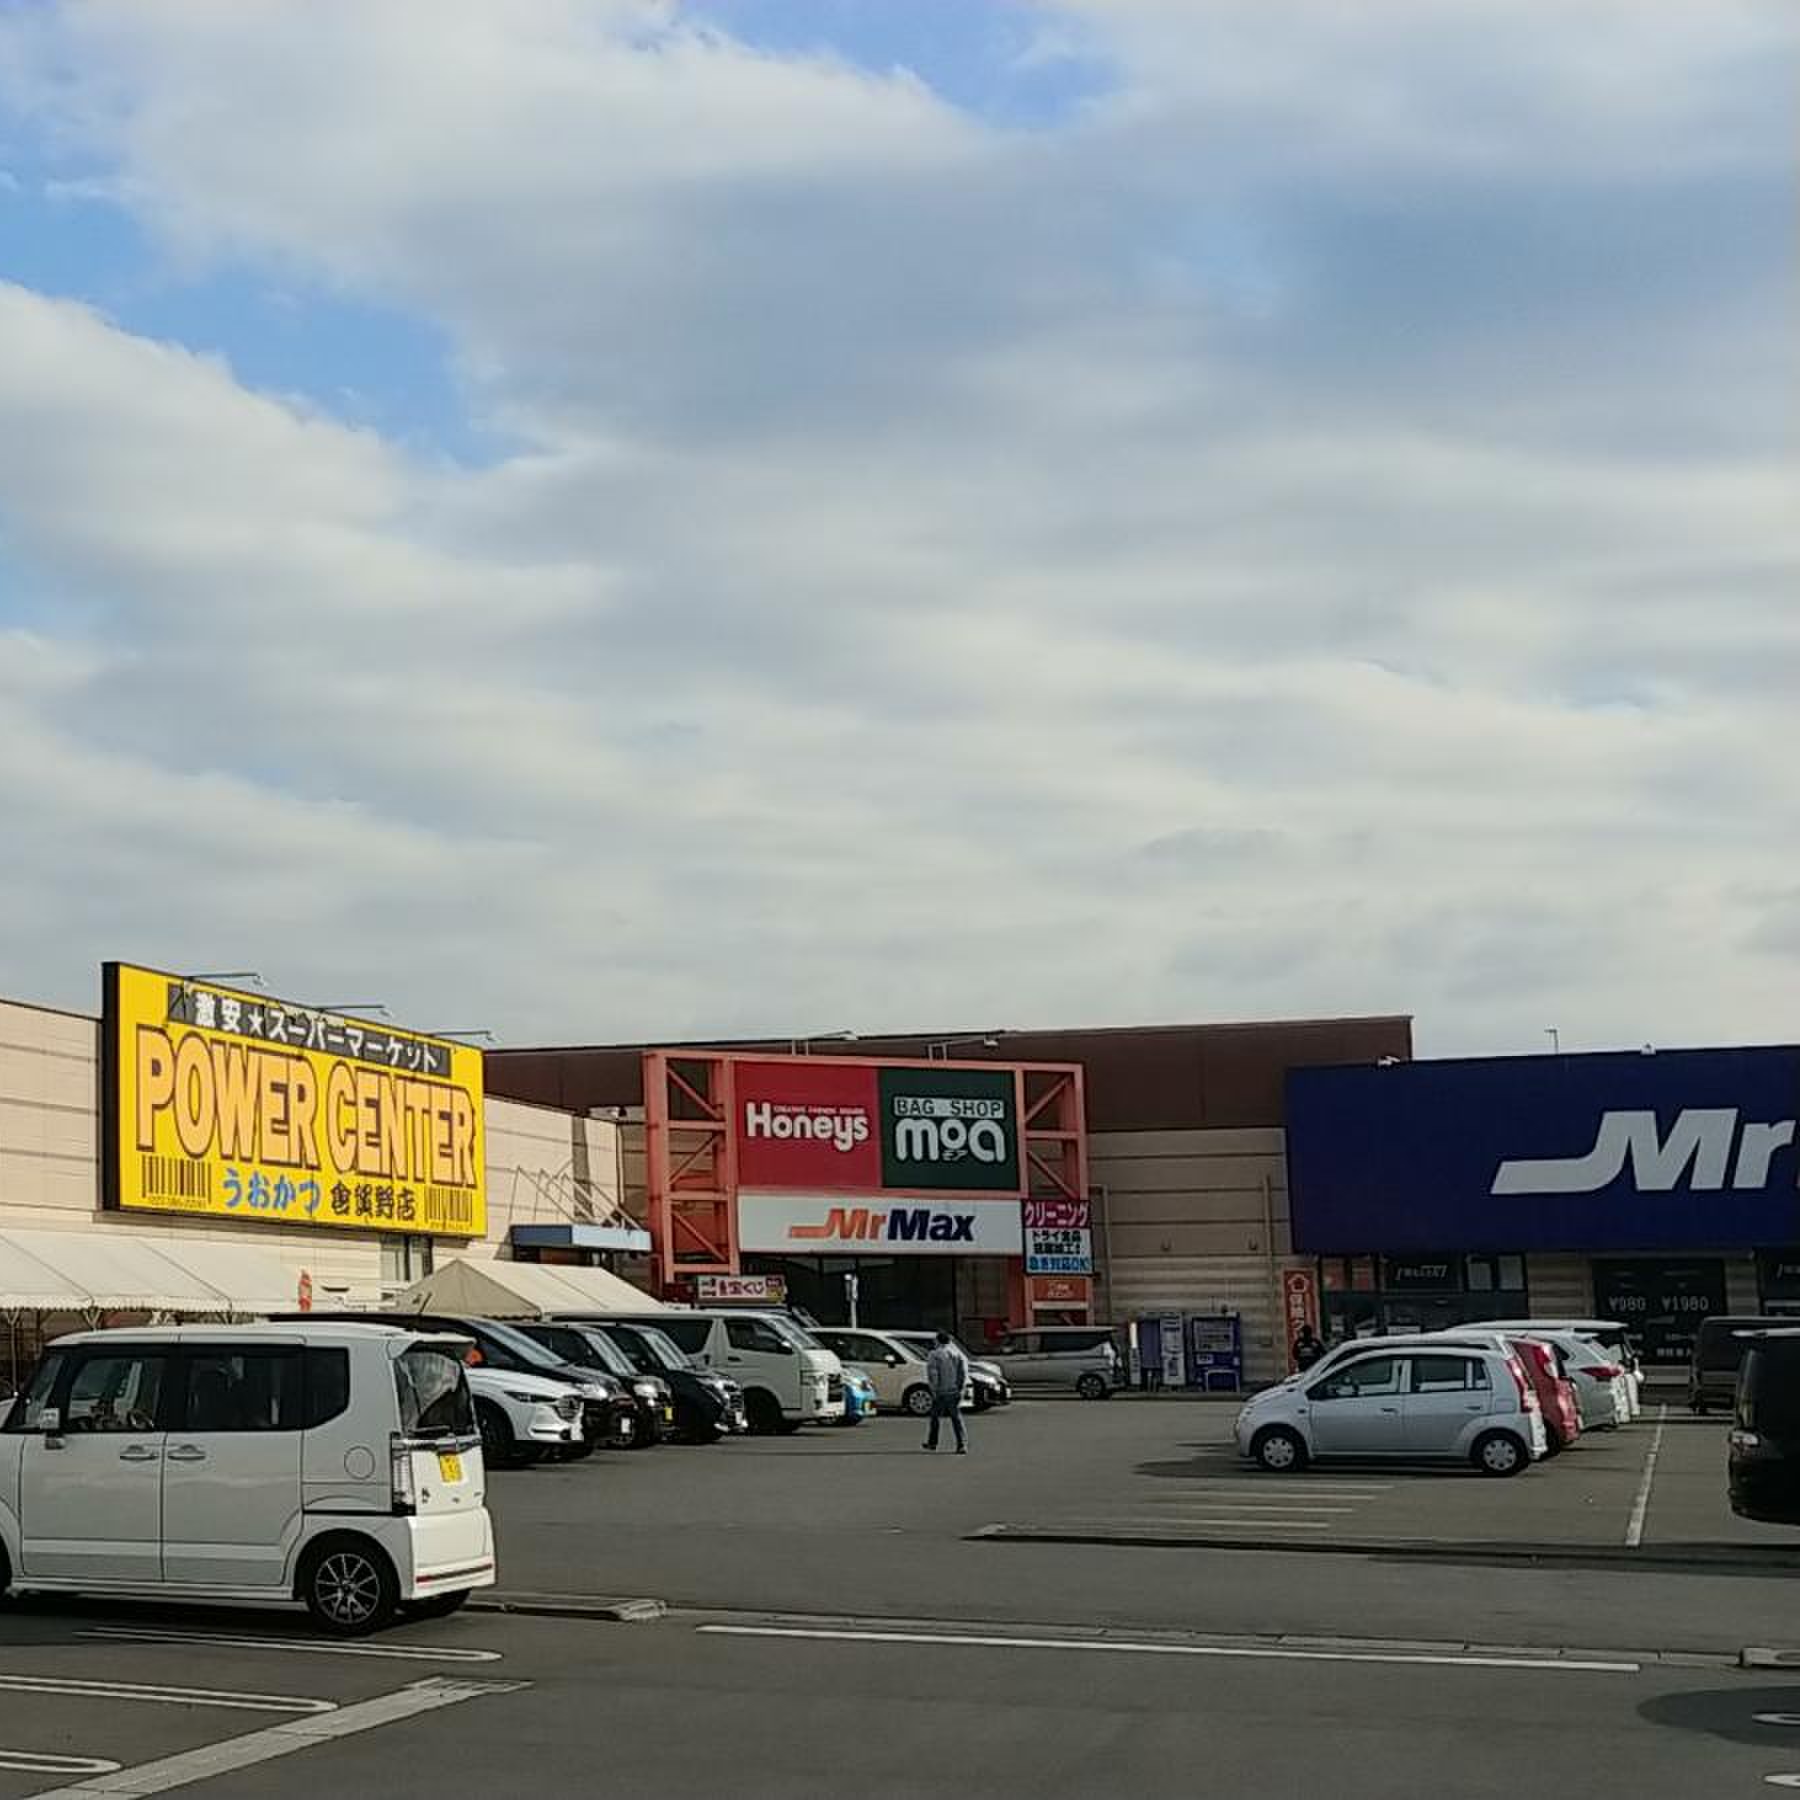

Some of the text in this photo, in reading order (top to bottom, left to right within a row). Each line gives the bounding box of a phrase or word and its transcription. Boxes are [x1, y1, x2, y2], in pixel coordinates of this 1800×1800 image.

[136, 1023, 478, 1189] POWER CENTER
[746, 1101, 869, 1152] Honeys
[897, 1099, 1002, 1117] BAG SHOP
[895, 1117, 1006, 1163] moa
[788, 1207, 977, 1243] MrMax
[1024, 1200, 1089, 1227] クリーニング
